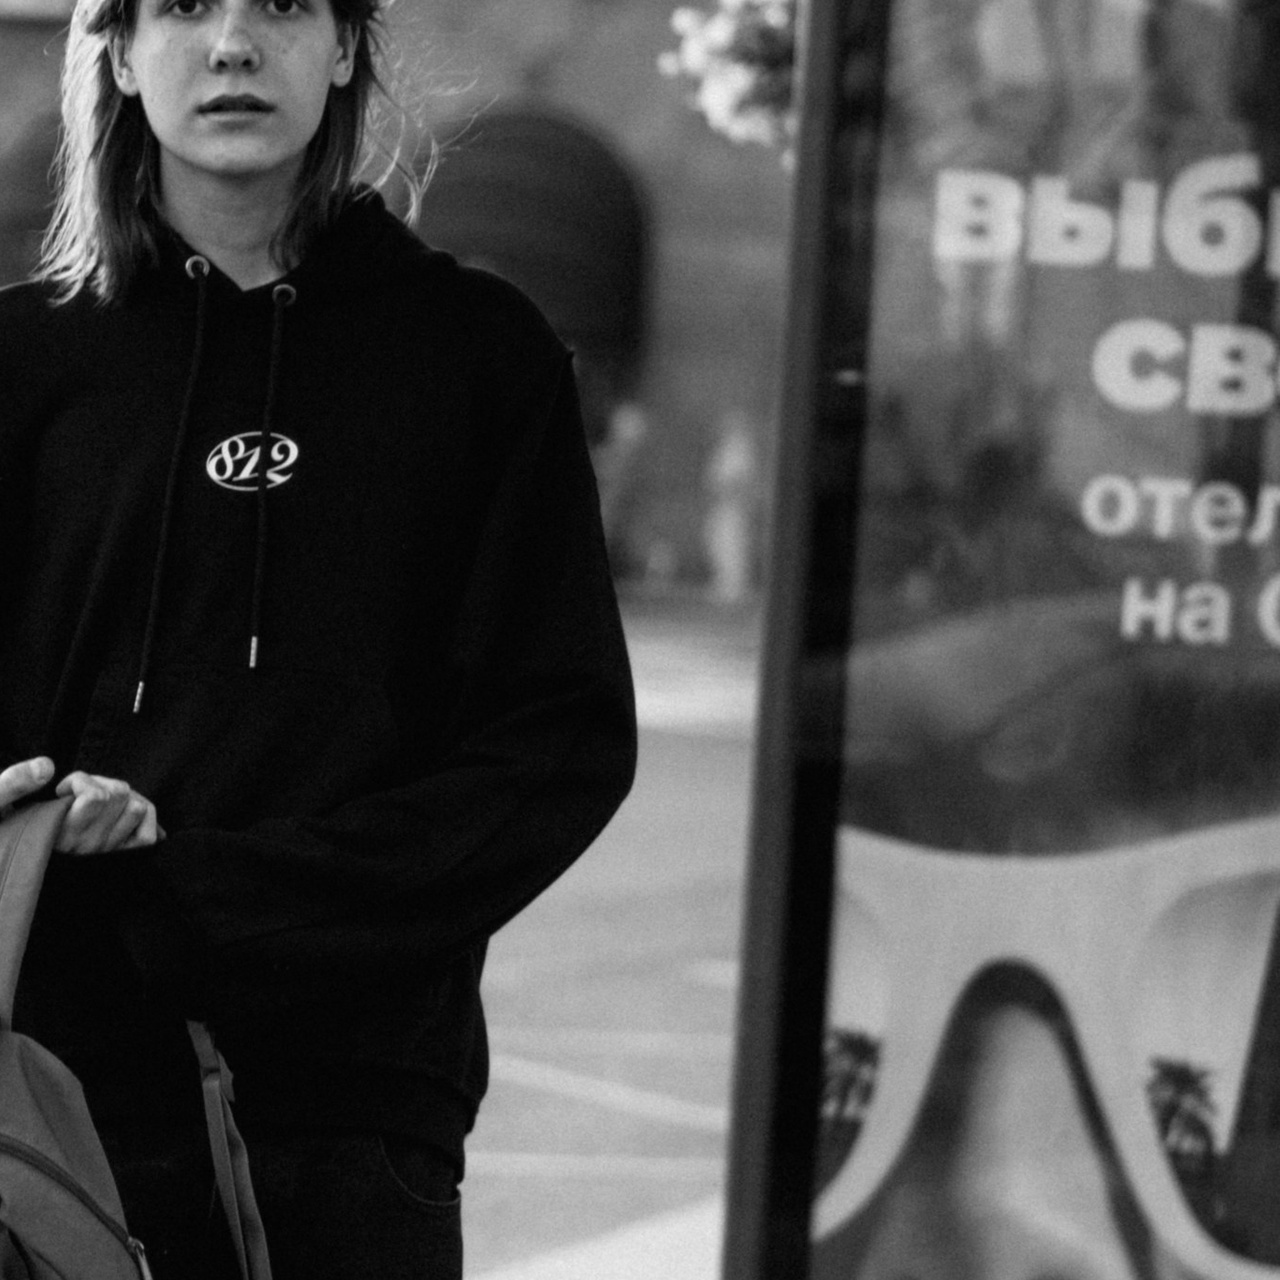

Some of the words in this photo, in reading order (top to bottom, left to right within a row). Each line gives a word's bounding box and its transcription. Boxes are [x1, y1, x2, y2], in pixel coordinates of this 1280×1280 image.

[933, 153, 1280, 277] выб
[1092, 320, 1280, 416] св
[206, 432, 299, 491] 812
[1122, 579, 1231, 644] на
